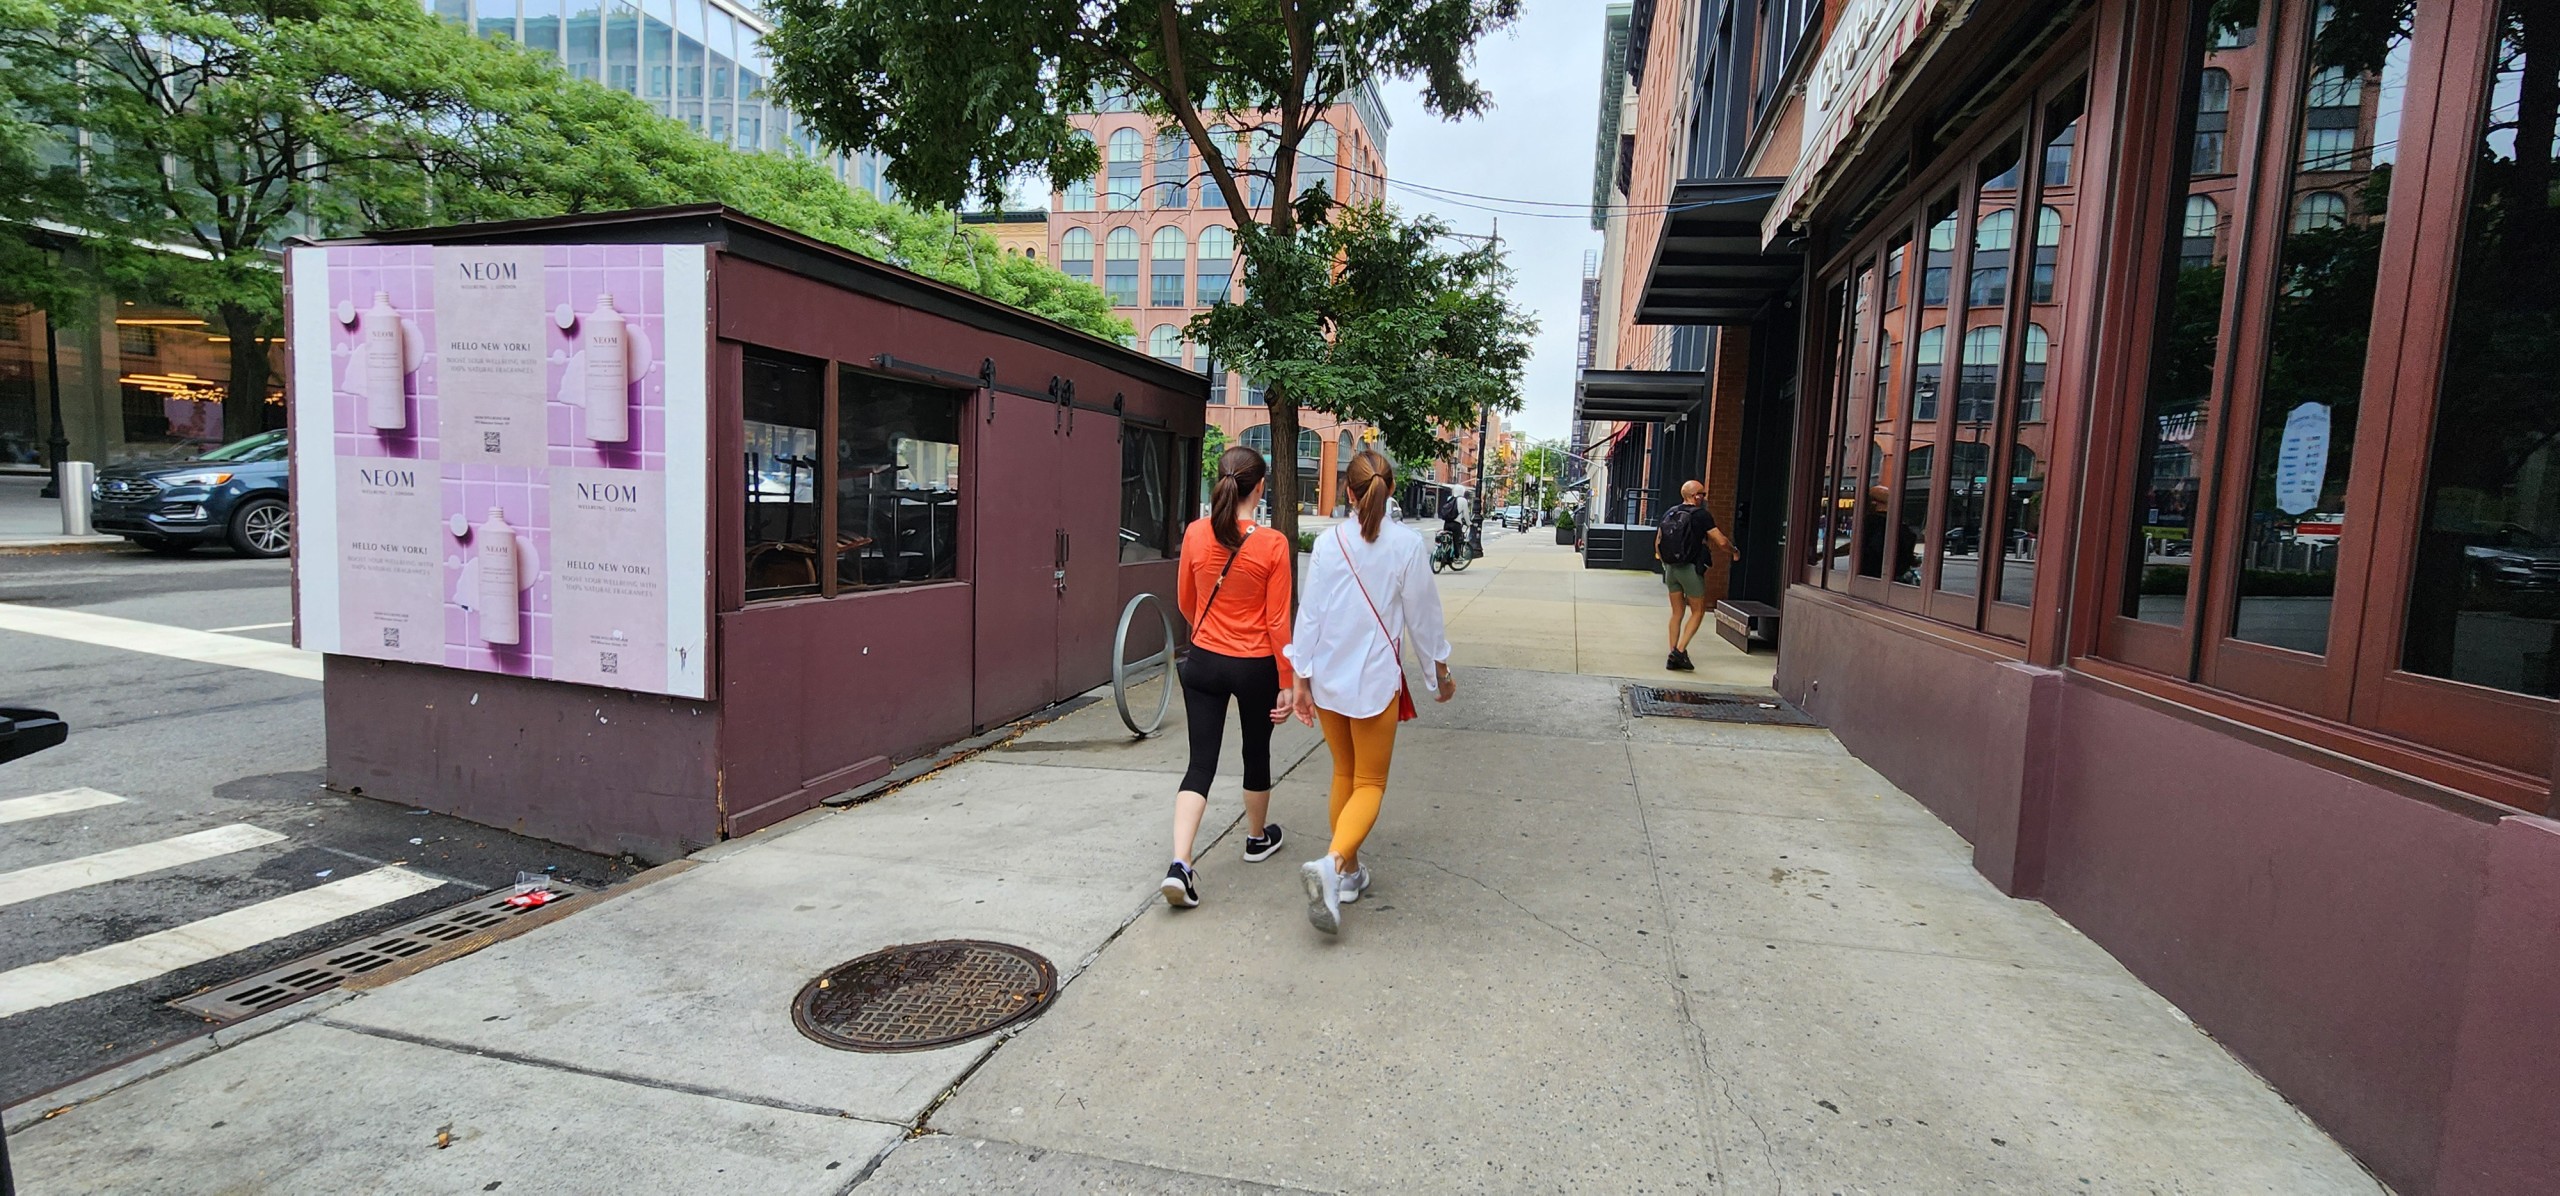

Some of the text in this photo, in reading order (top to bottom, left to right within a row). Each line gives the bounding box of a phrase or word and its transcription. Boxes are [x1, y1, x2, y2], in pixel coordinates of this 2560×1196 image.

[460, 262, 517, 281] NEOM
[451, 341, 531, 352] HELLO NEW YORK!
[361, 469, 414, 488] NEOM
[577, 482, 637, 503] NEOM
[352, 542, 428, 555] HELLO NEW YORK!
[567, 560, 651, 576] HELLO NEW YORK!
